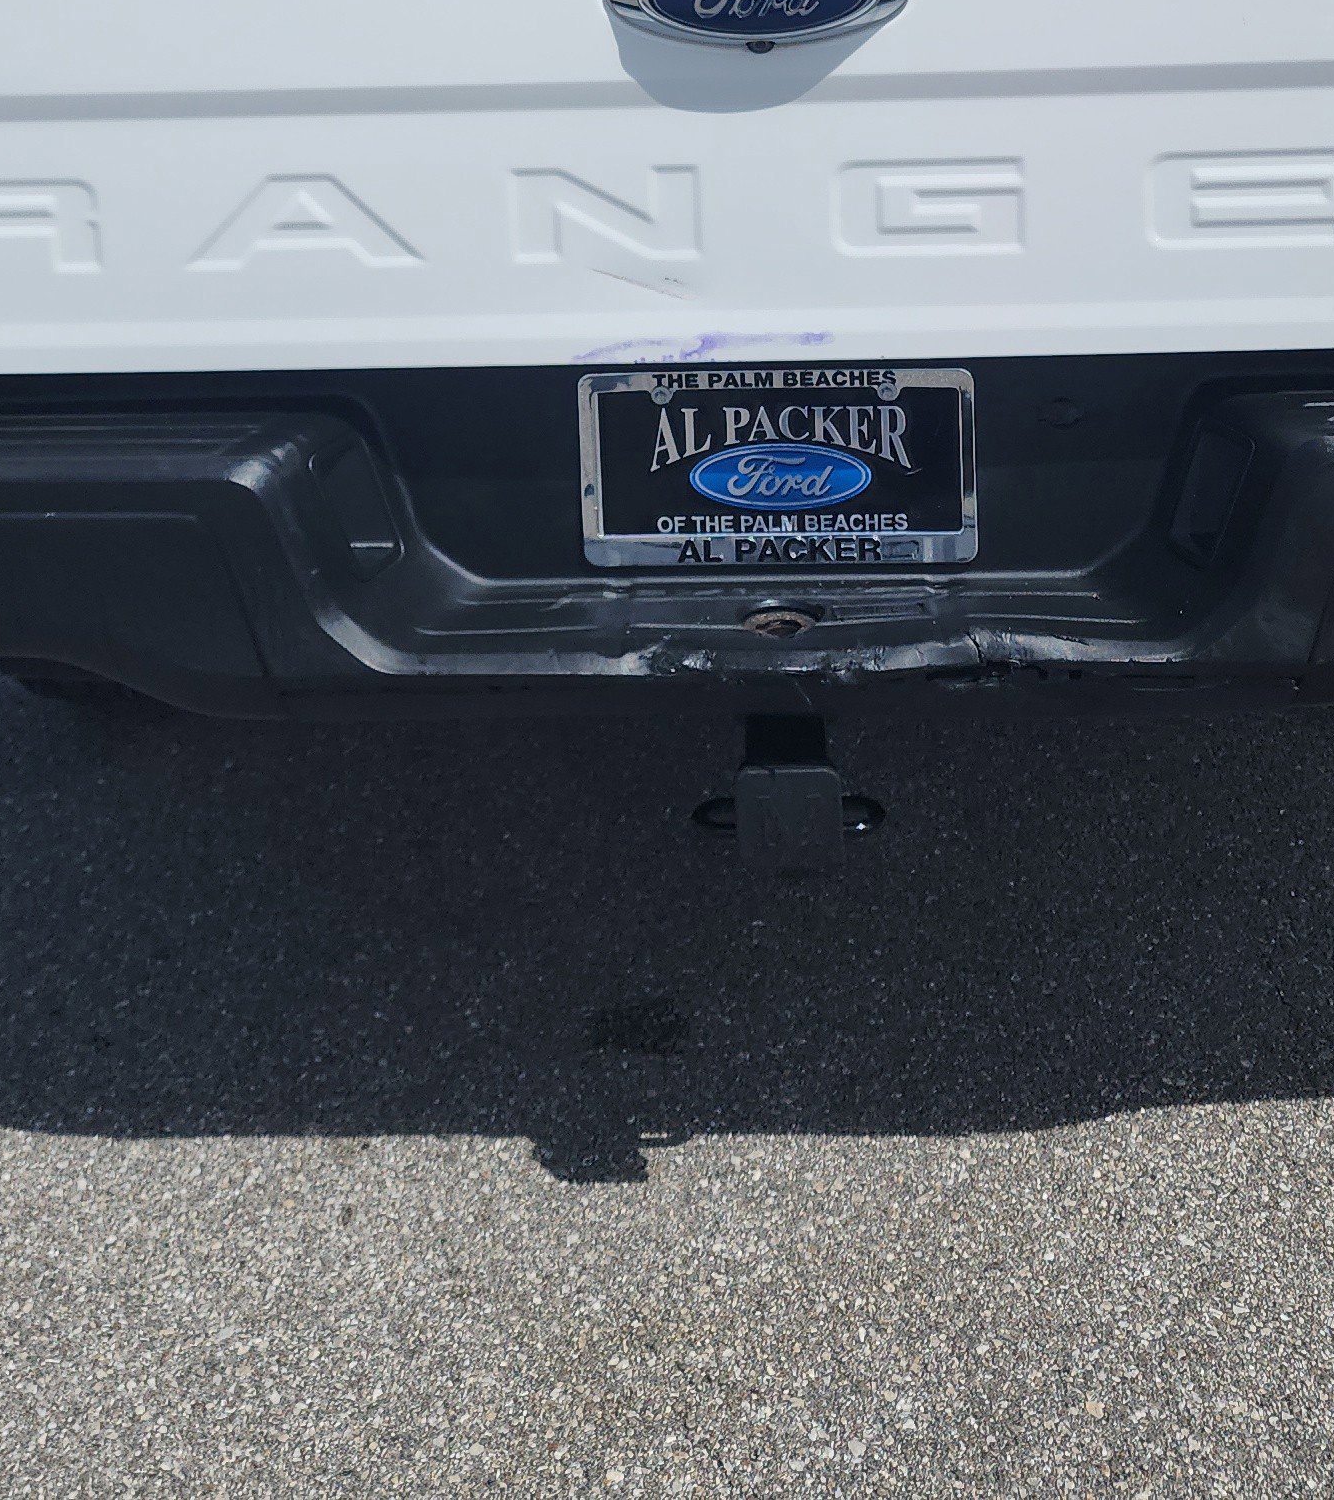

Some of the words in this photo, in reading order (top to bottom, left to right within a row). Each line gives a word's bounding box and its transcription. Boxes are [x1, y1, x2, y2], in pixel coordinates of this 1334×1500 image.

[652, 373, 700, 389] THE
[708, 371, 774, 389] PALM
[782, 369, 897, 388] BEACHES
[649, 407, 711, 472] AL
[723, 405, 912, 469] PACKER
[727, 454, 834, 496] Ford
[657, 515, 687, 533] OF
[691, 515, 735, 533] THE
[740, 514, 799, 532] PALM
[804, 513, 909, 532] BEACHES
[678, 537, 724, 564] AL
[734, 536, 883, 563] PACKER
